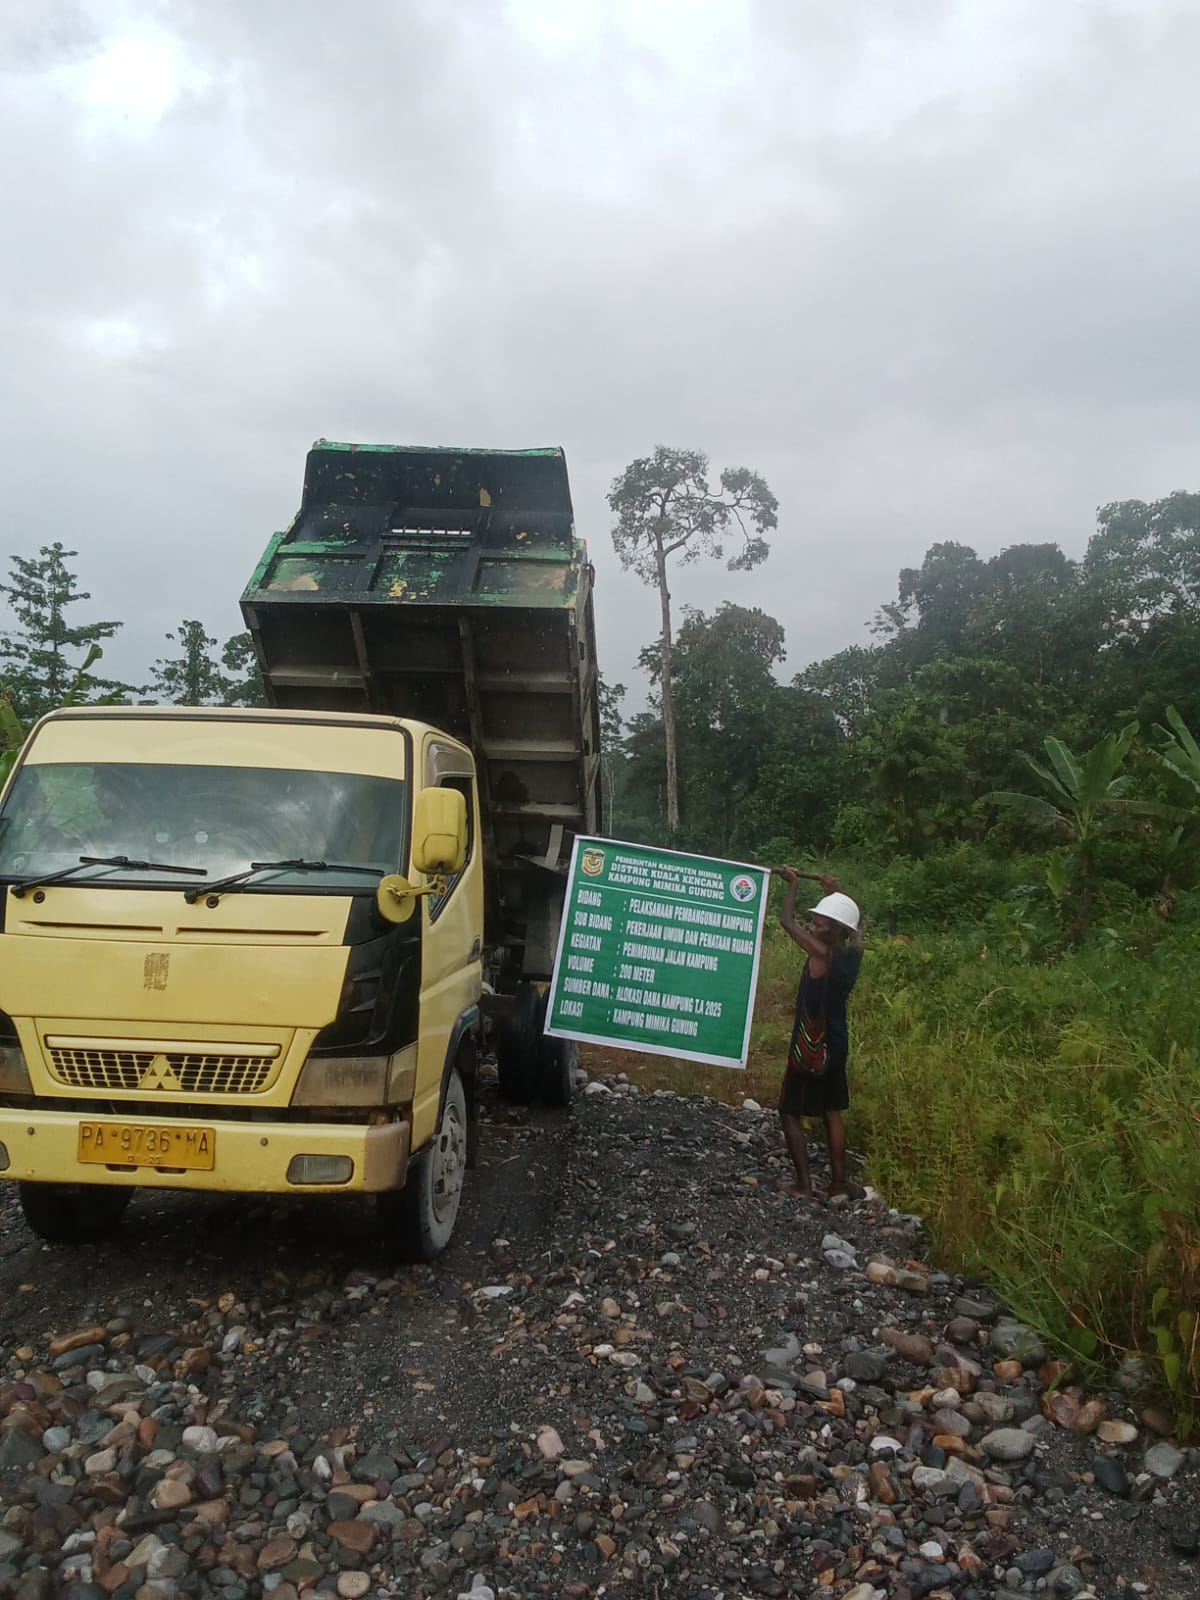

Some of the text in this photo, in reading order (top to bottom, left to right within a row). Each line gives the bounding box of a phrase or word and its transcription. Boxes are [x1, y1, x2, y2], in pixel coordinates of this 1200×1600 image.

[611, 863, 648, 876] DISTRIK
[651, 870, 679, 882] KUALA
[616, 856, 722, 880] PEMERINTAH KABUPATEN MIMIKA
[608, 872, 724, 900] KAMPUNG MIMIKA GUNUNG
[578, 890, 601, 907] BIDANG
[629, 898, 674, 919] PELAKSANAAN
[674, 906, 721, 928] PEMBANGUNAN
[722, 914, 753, 933] KAMPUNG
[574, 911, 588, 926] SUB
[588, 913, 612, 931] BIDANG
[626, 920, 663, 940] PEKERJAAN
[663, 926, 684, 943] UMUM
[685, 930, 698, 946] DAN
[699, 932, 731, 951] PENATAAN
[732, 938, 754, 955] RUANG
[571, 933, 601, 951] KEGIATAN
[665, 949, 686, 966] JALAN
[686, 952, 718, 971] KAMPUNG
[568, 955, 594, 972] VOLUME
[619, 964, 632, 979] 200
[632, 966, 655, 984] METER
[564, 977, 592, 994] SUMBER
[592, 980, 610, 998] DANA
[616, 986, 643, 1005] ALOKASI
[643, 991, 660, 1007] DANA
[661, 994, 694, 1013] KAMPUNG
[705, 1001, 722, 1017] 2025
[560, 1000, 584, 1017] LOKASI
[613, 1008, 645, 1028] KAMPUNG
[645, 1013, 670, 1032] MIMIKA
[671, 1018, 698, 1036] GUNUNG
[82, 1124, 104, 1149] PA
[121, 1127, 169, 1152] 9736
